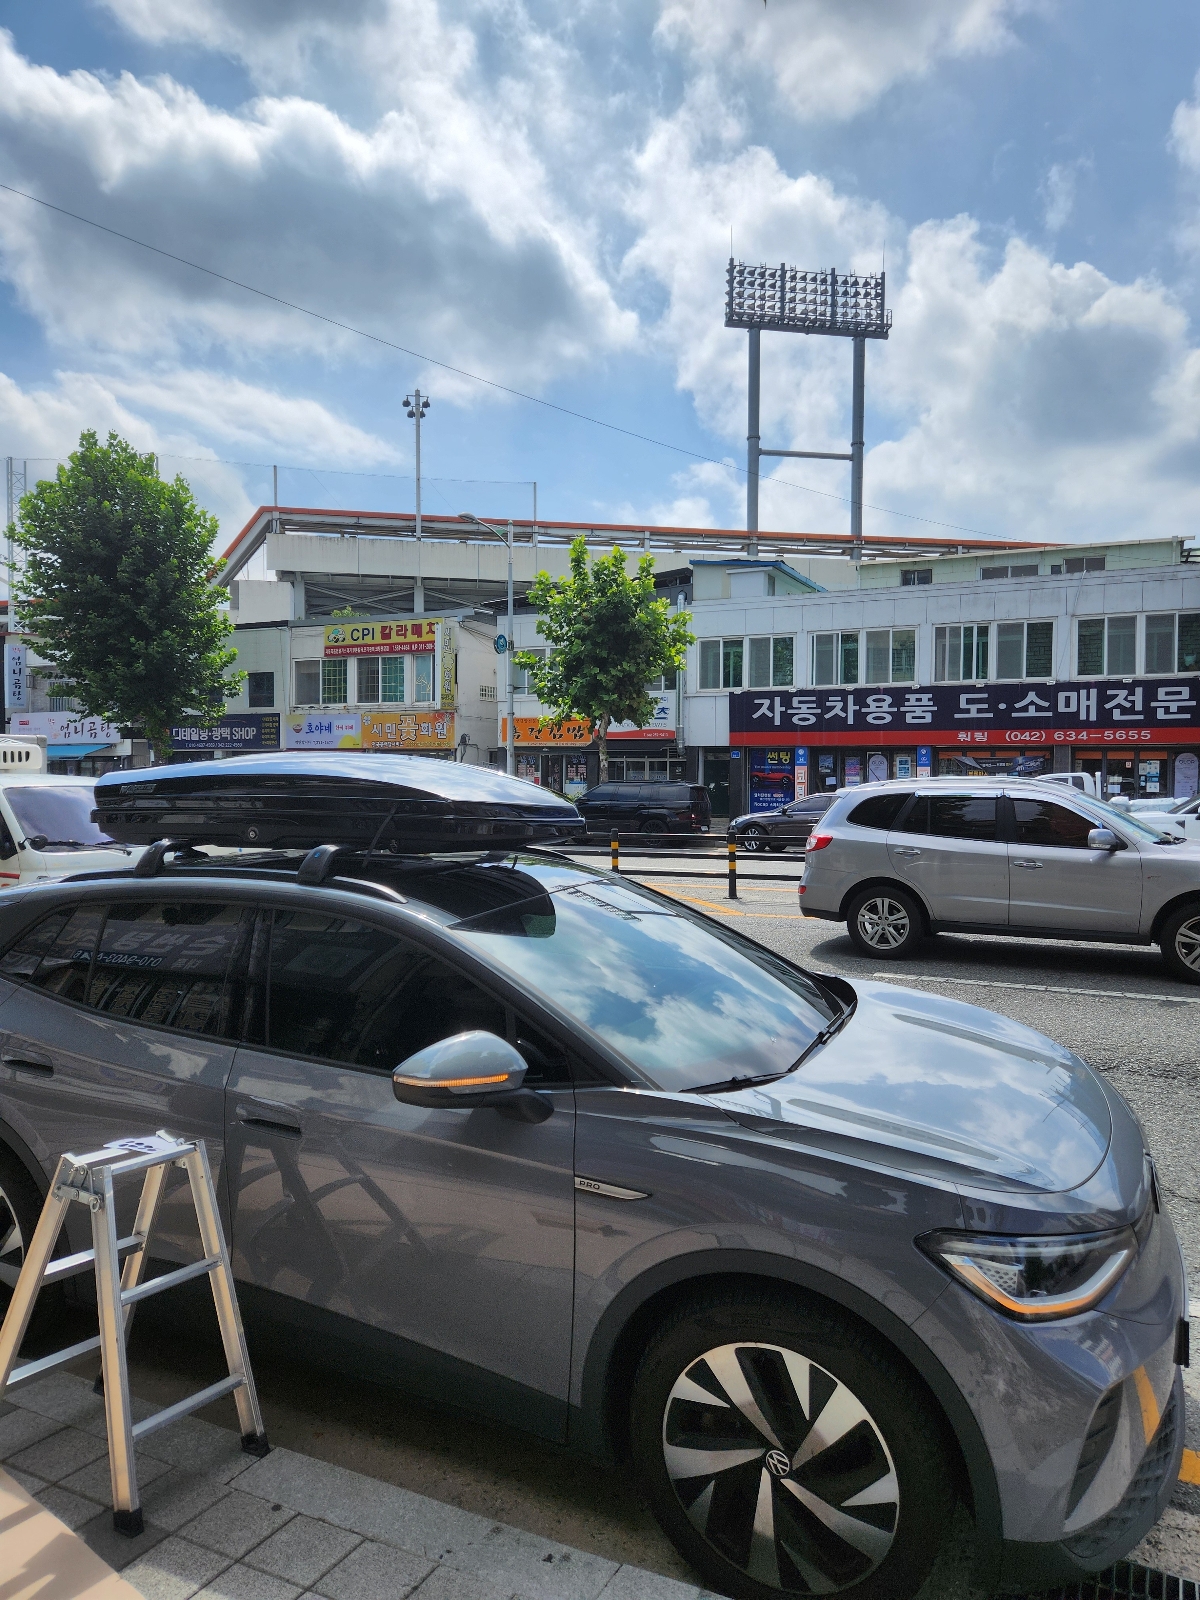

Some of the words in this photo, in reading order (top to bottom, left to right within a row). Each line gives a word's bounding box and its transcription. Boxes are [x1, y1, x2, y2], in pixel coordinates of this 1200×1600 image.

[350, 627, 375, 642] CPI
[11, 656, 22, 701] 엄니곰탕
[751, 693, 938, 726] 자동차용품
[954, 686, 1197, 722] 도·소매전문
[60, 721, 111, 739] 엄니곰탕
[232, 727, 257, 740] SHOP
[305, 721, 332, 735] 호야네
[370, 714, 448, 741] 시민꽃화원
[1005, 730, 1046, 742] (042)
[1053, 730, 1152, 741] 634-5655
[767, 751, 791, 764] 썬팅
[579, 1180, 600, 1190] PRO
